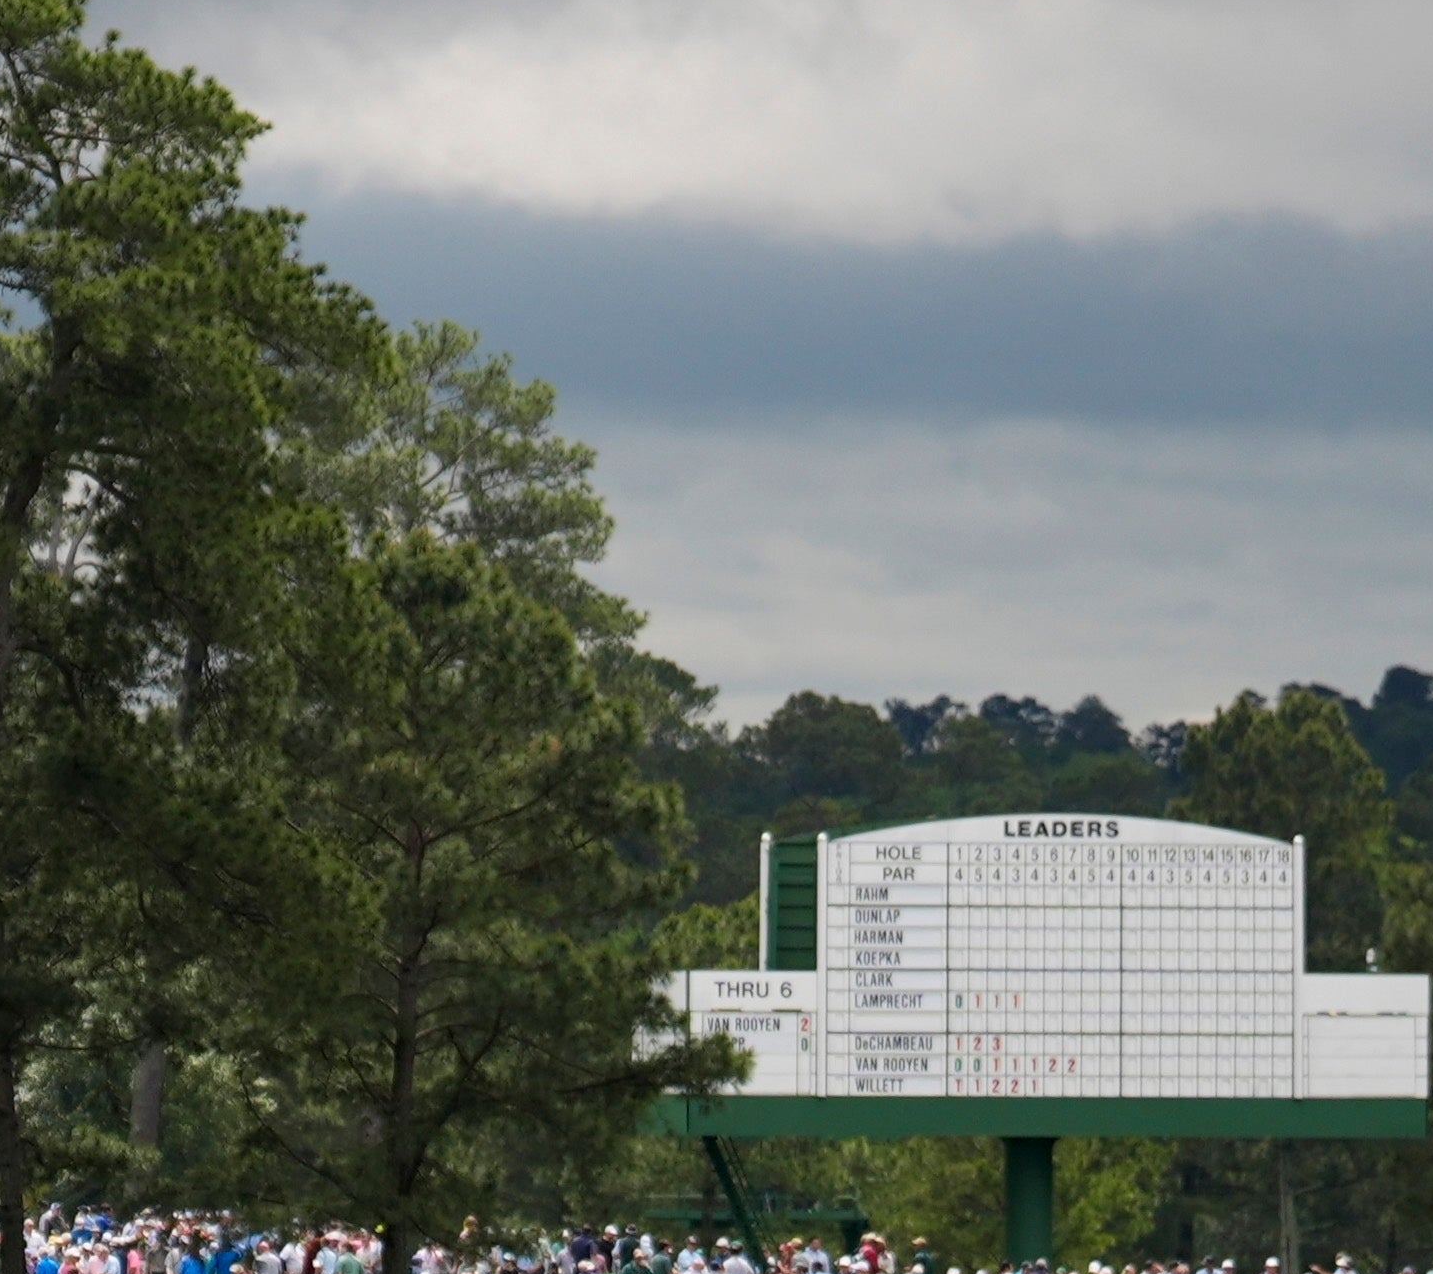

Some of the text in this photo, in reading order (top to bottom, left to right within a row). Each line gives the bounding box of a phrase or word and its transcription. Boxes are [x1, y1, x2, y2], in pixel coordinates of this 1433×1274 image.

[1005, 821, 1118, 837] LEADERS
[876, 846, 921, 860] HOLE
[974, 847, 983, 861] 2
[993, 847, 1002, 862] 3
[1012, 848, 1020, 861] 4
[1031, 848, 1040, 862] 5
[1049, 847, 1059, 862] 6
[1070, 847, 1077, 861] 7
[1087, 849, 1096, 863] 8
[1106, 848, 1116, 862] 9
[1126, 848, 1140, 862] 10
[1147, 849, 1158, 862] 11
[1164, 847, 1177, 862] 12
[1183, 849, 1196, 863] 13
[1202, 850, 1214, 862] 14
[1221, 849, 1234, 863] 15
[1239, 849, 1252, 862] 16
[1258, 847, 1271, 862] 17
[1277, 850, 1290, 864] 18
[883, 867, 1287, 884] PAR 4 5 4 3 4 3 4 5 4 4 4 3 5 4 5 3 4 4
[856, 887, 888, 900] RAHM
[855, 931, 903, 943] HARMAN
[856, 951, 900, 965] KOEPKA
[855, 971, 893, 986] CLARK
[714, 981, 793, 998] THRU 6
[855, 994, 922, 1008] LAMPRECHT
[955, 995, 963, 1009] 0
[708, 1017, 809, 1032] VAN ROOYEN 2
[800, 1038, 809, 1052] 0
[855, 1035, 933, 1050] DeCHAMBEAU
[974, 1037, 982, 1051] 2
[993, 1035, 1001, 1050] 3
[856, 1057, 877, 1071] VAN
[884, 1058, 928, 1071] ROOYEN
[954, 1058, 963, 1072] 0
[973, 1058, 982, 1072] 0
[1048, 1058, 1057, 1072] 2
[1068, 1059, 1076, 1073] 2
[856, 1078, 903, 1092] WILLETT
[992, 1079, 1001, 1093] 2
[1011, 1079, 1019, 1093] 2
